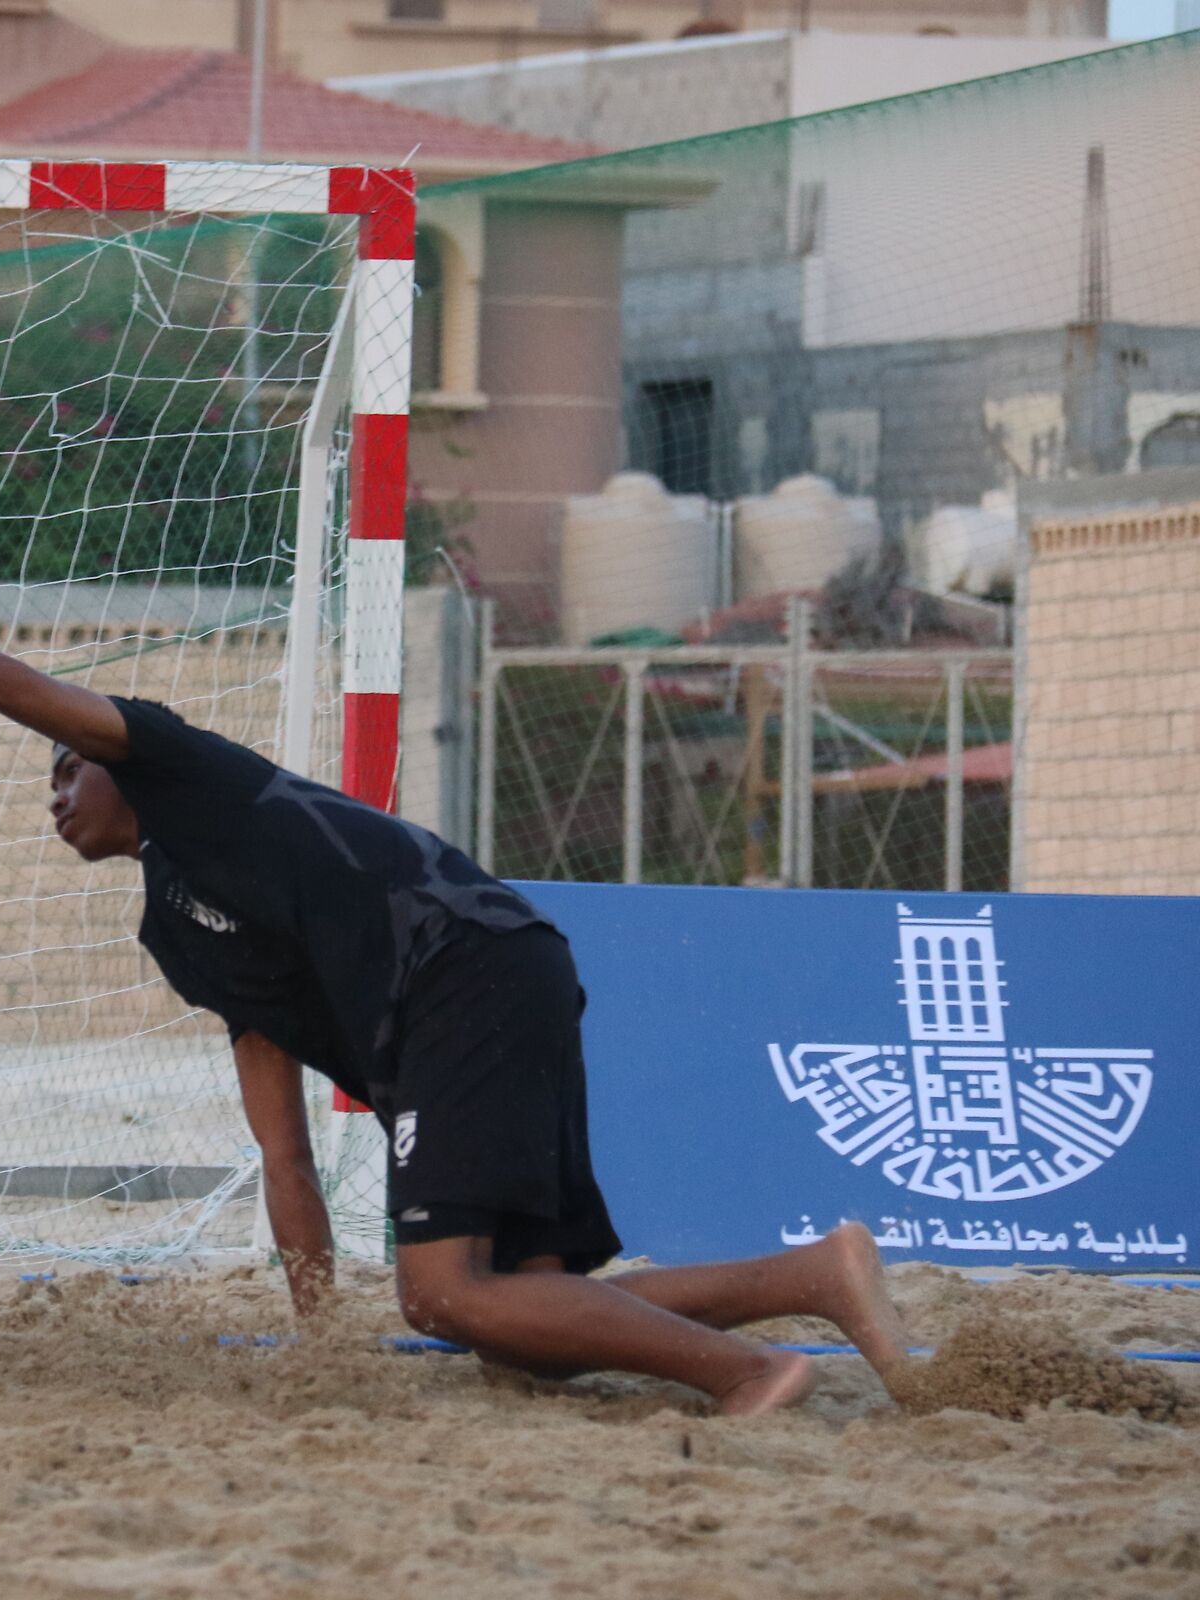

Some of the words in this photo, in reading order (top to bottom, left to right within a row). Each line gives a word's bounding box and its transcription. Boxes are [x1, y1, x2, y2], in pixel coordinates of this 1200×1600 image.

[780, 1214, 924, 1249] القف
[927, 1216, 1070, 1252] محافظة
[1073, 1221, 1188, 1264] بلدية
